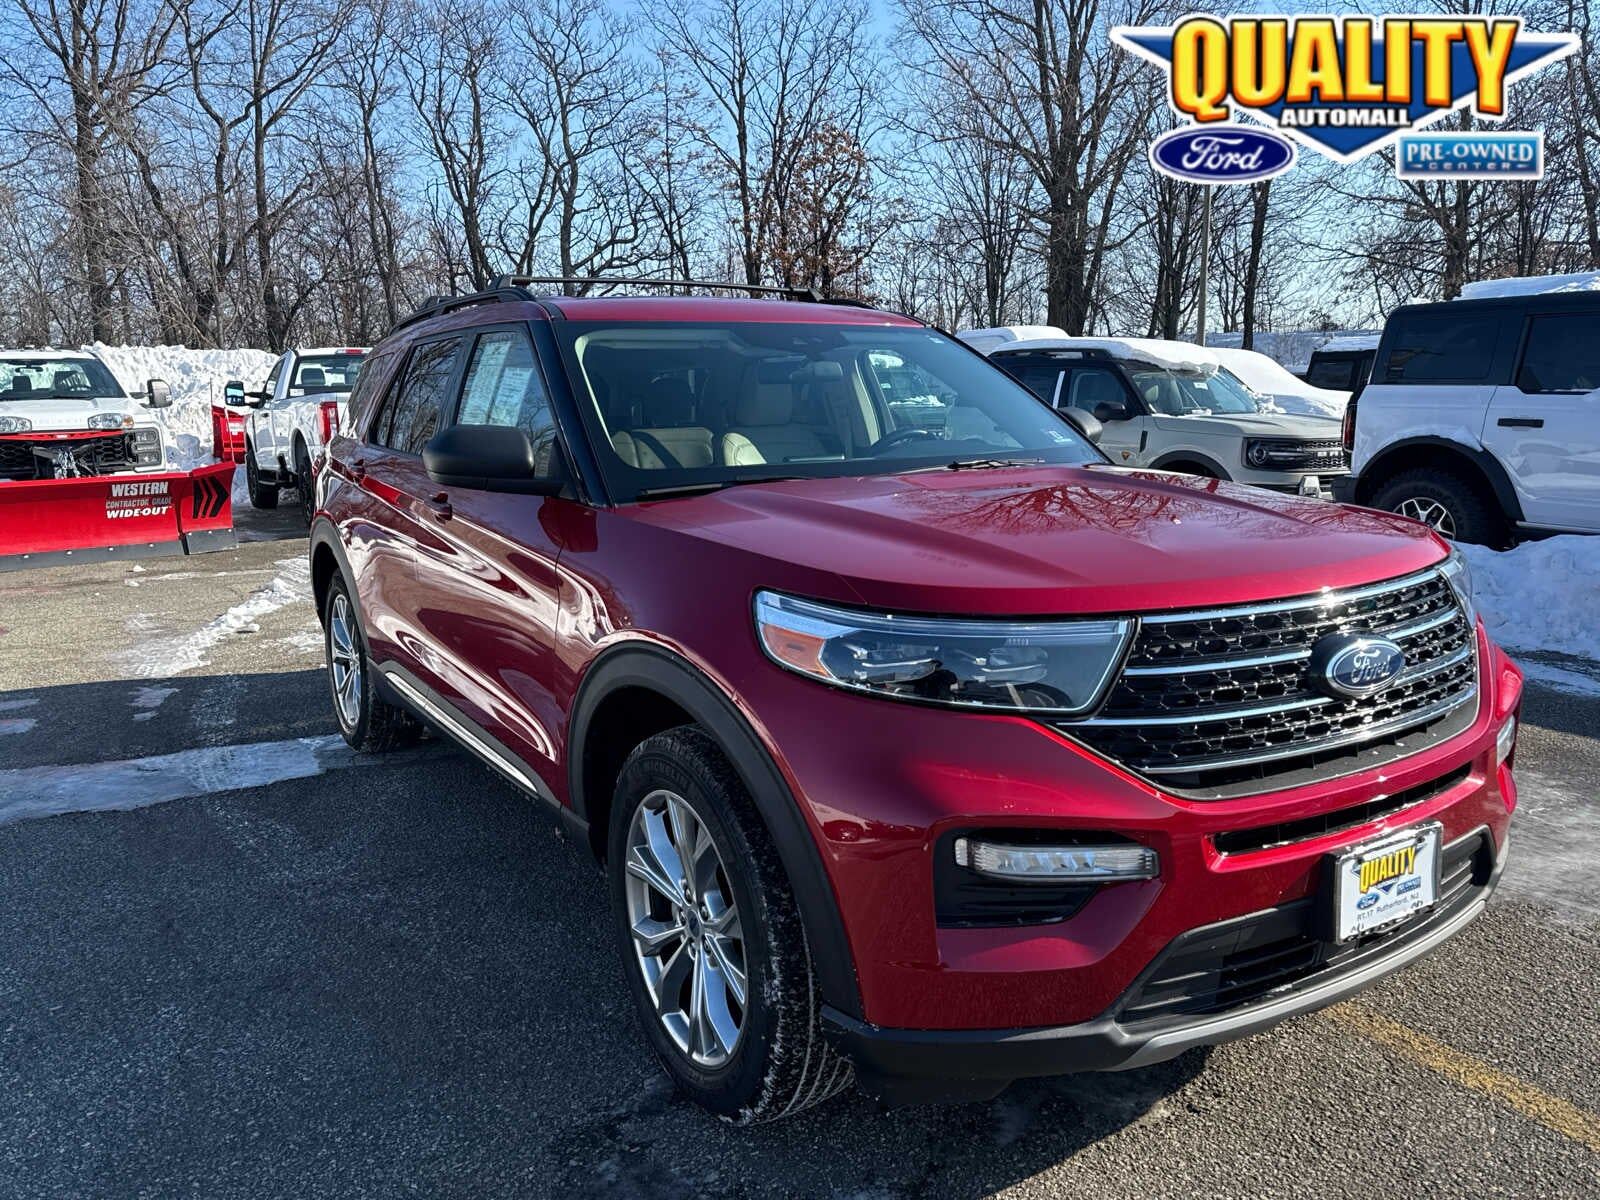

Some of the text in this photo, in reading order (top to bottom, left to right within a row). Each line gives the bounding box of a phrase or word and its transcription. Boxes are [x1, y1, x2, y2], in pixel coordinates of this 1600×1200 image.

[111, 482, 168, 497] WESTERN
[1351, 649, 1391, 683] Ford
[1360, 846, 1416, 893] QUALITY
